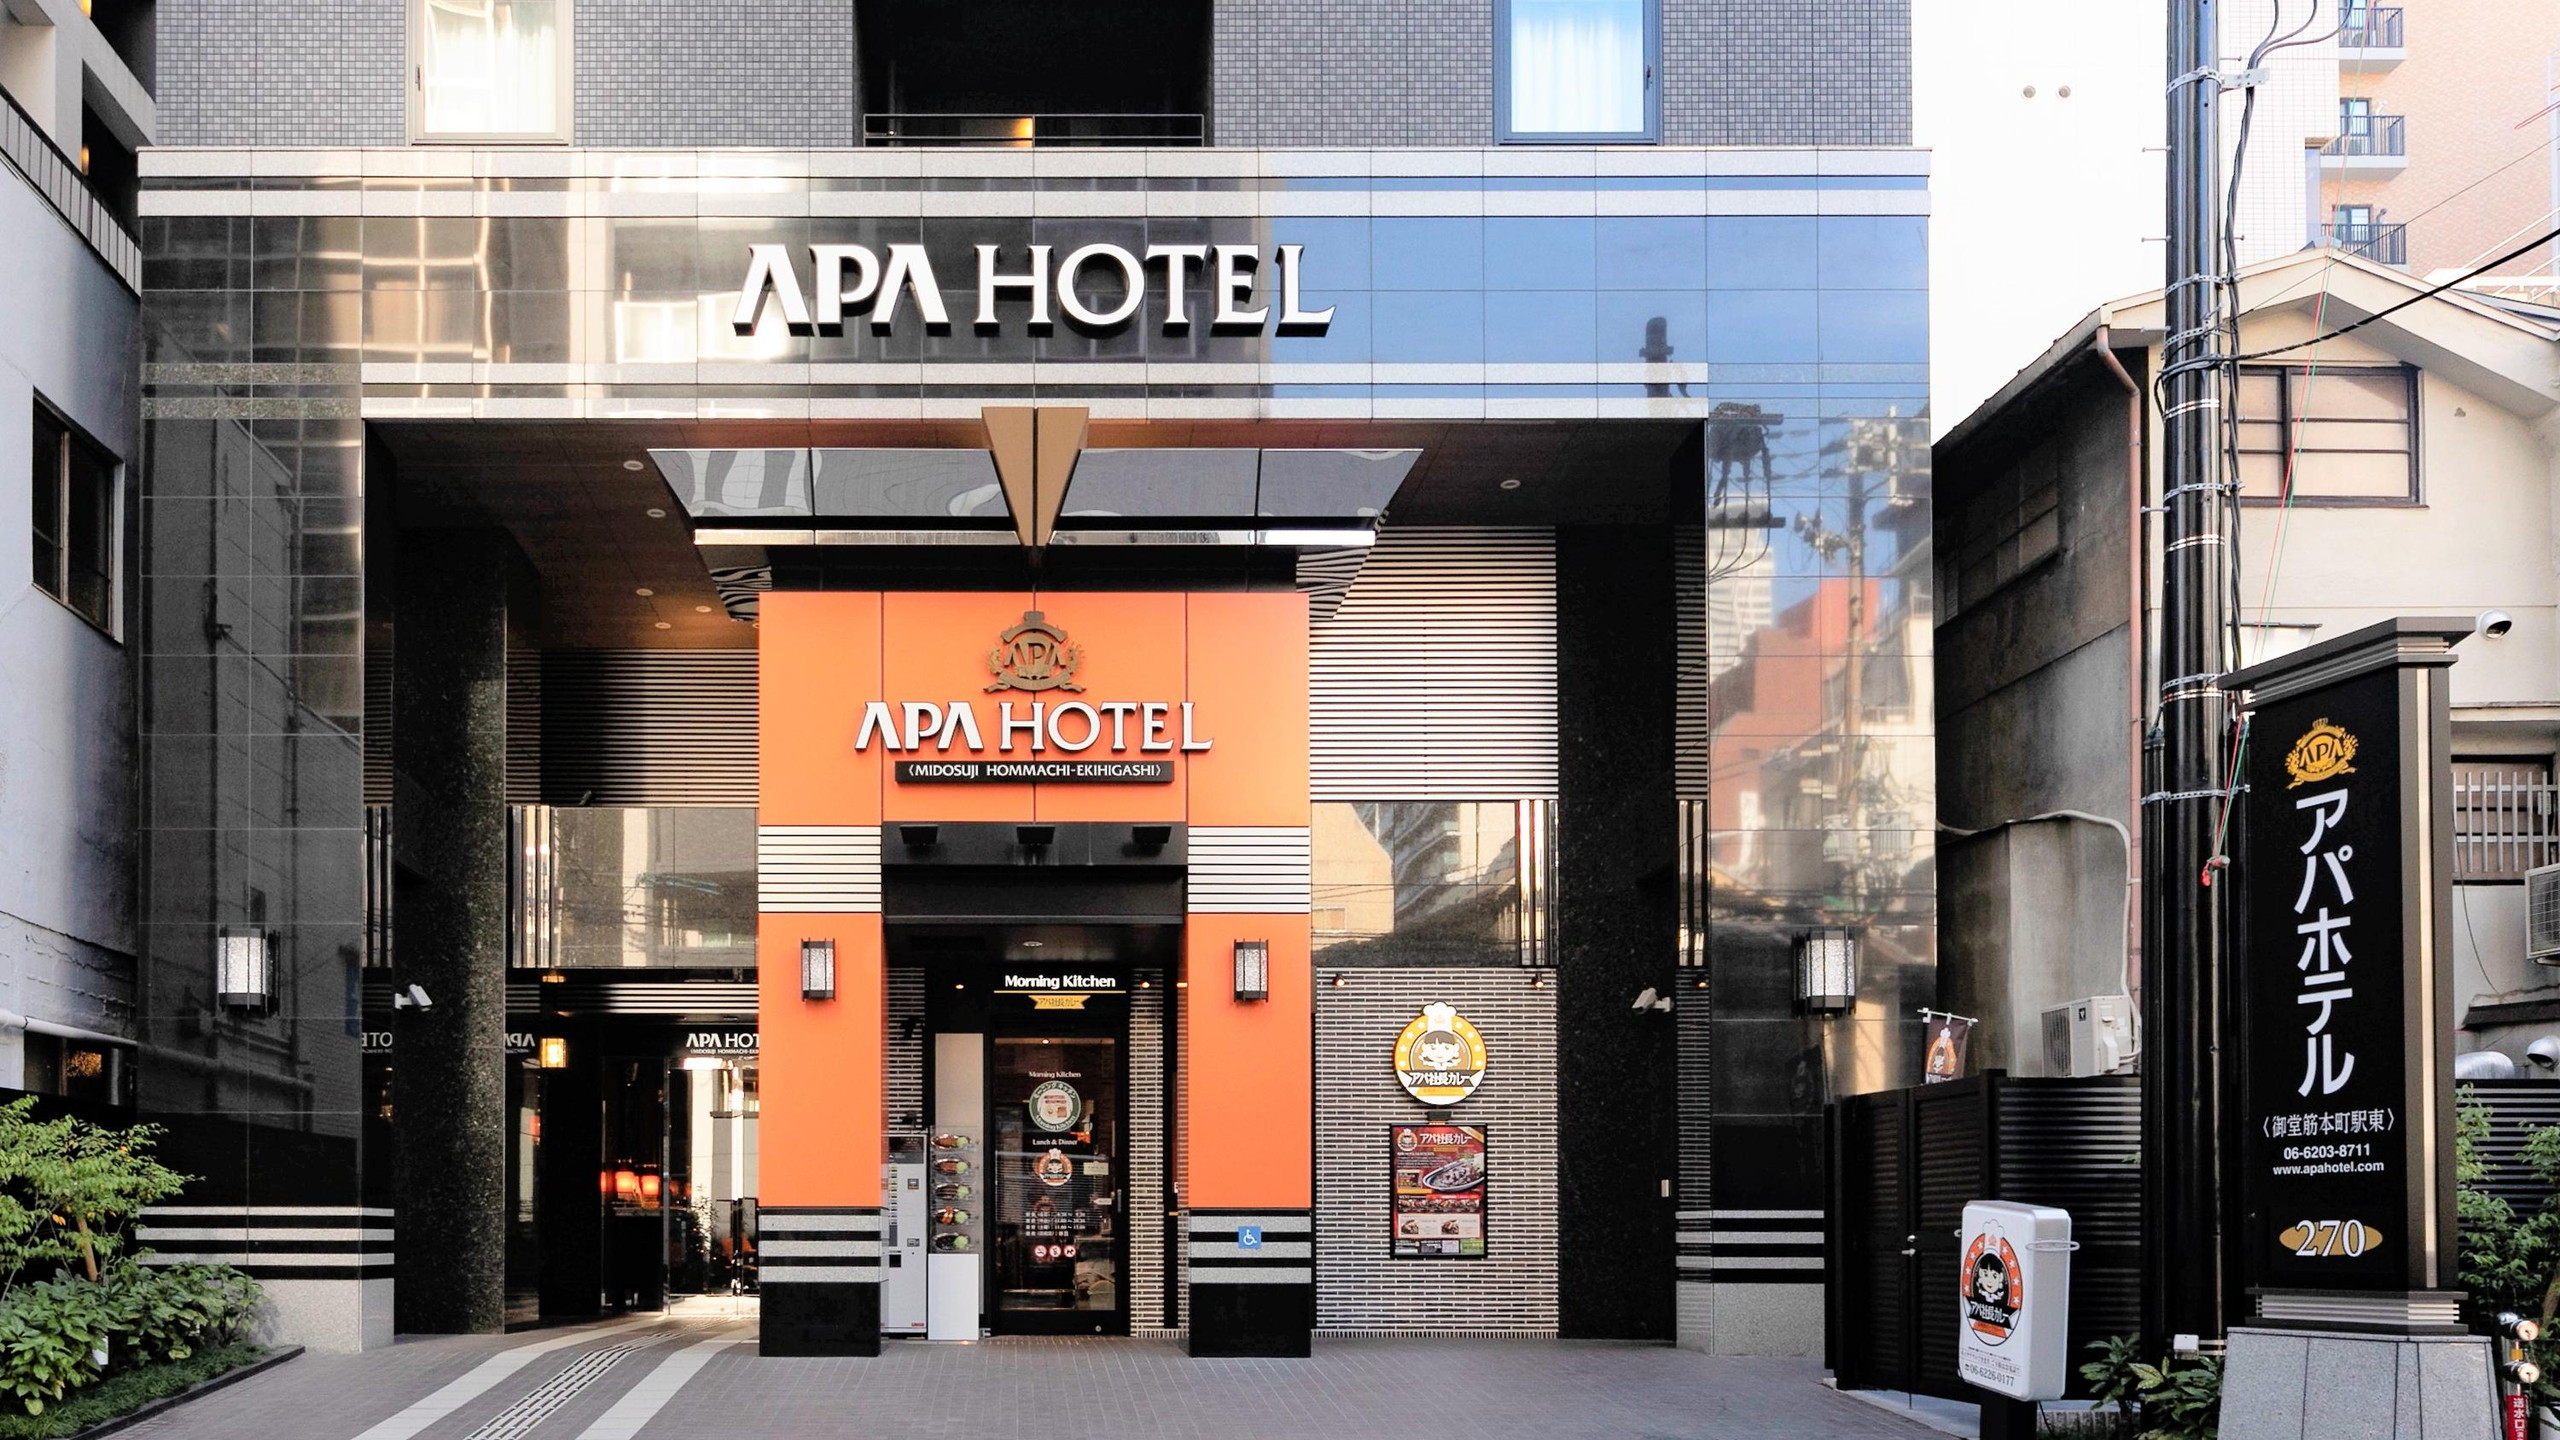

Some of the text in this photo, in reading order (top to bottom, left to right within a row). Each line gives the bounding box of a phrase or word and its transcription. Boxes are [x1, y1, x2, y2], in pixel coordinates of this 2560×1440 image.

[732, 243, 1337, 337] APA HOTEL
[1004, 641, 1066, 668] APA
[855, 700, 1214, 752] APA HOTEL
[2300, 739, 2345, 768] APA
[2294, 788, 2355, 1097] アパホテル
[1005, 974, 1116, 989] Morning Kitchen
[686, 1033, 722, 1048] APA
[1409, 1072, 1471, 1086] アパ社長カレー
[1419, 1133, 1473, 1145] アパ社長カレー
[2283, 1143, 2371, 1160] 06-6203-8711
[2273, 1161, 2385, 1176] www.apahotel.com
[2295, 1219, 2366, 1257] 270
